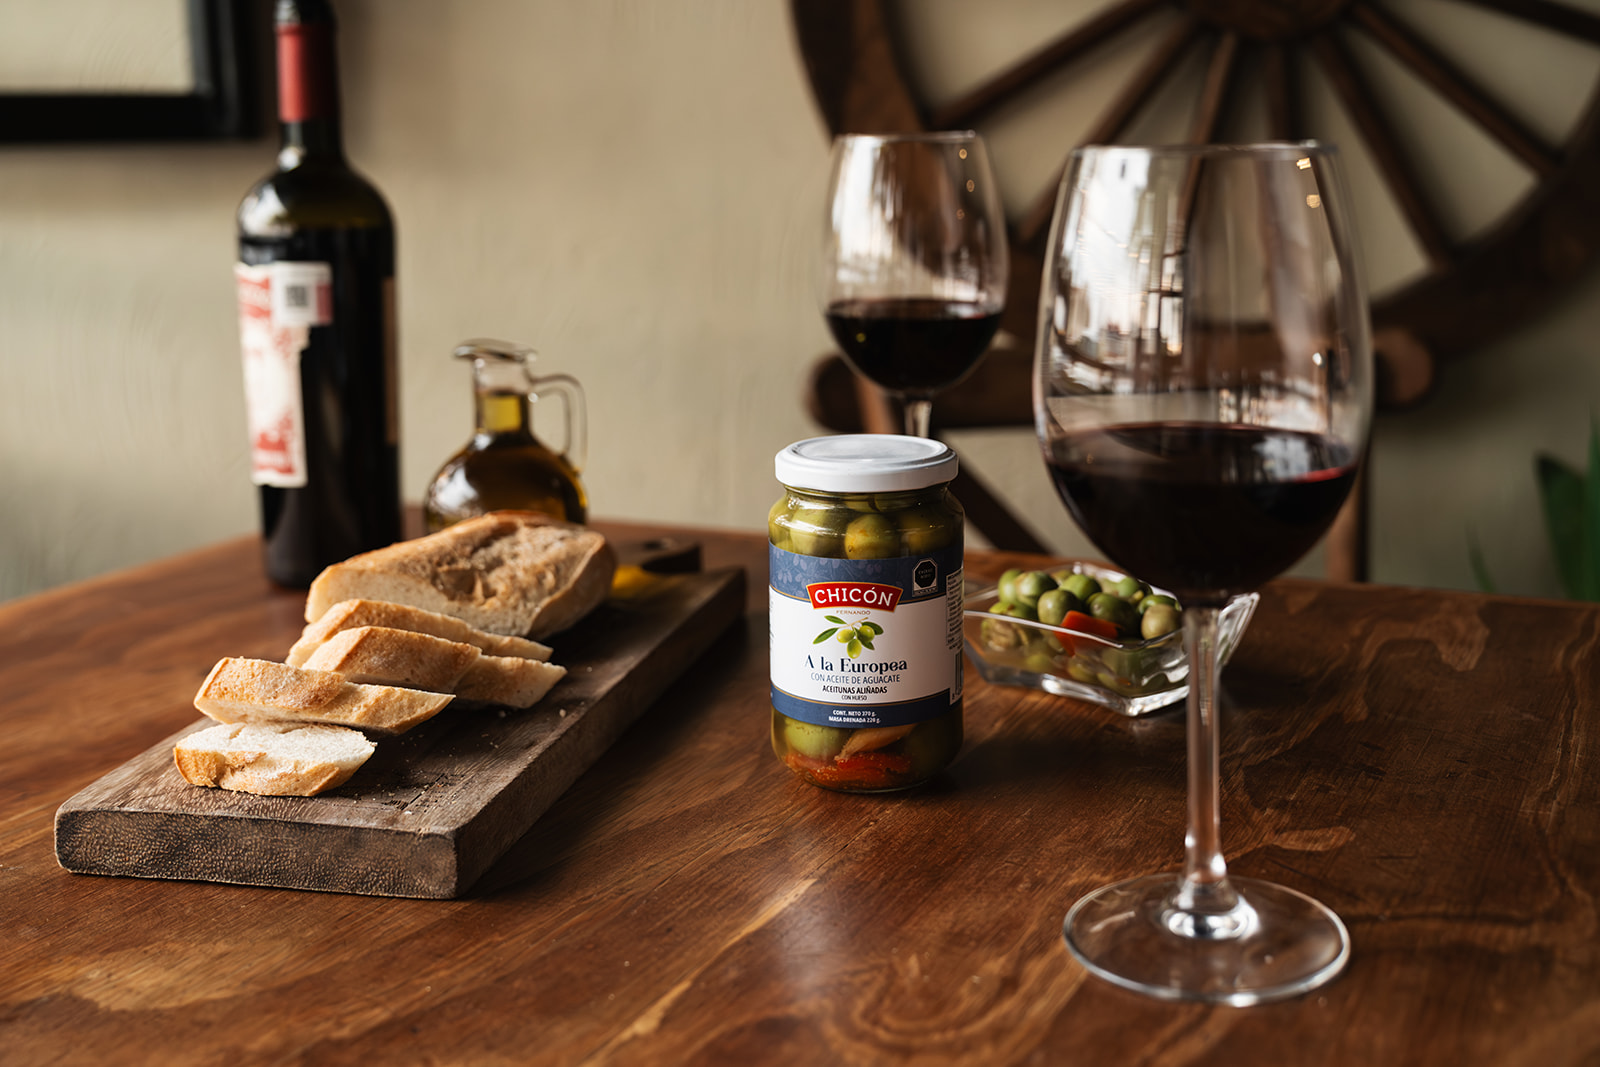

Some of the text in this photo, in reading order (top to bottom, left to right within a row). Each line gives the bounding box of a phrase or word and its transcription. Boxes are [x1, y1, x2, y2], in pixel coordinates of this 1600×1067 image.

[815, 587, 893, 606] CHICÓN
[805, 654, 907, 674] A la Europea
[811, 672, 900, 684] CON ACEITE DE AGUACATE
[822, 685, 888, 694] ACEITUNAS ALIÑADAS
